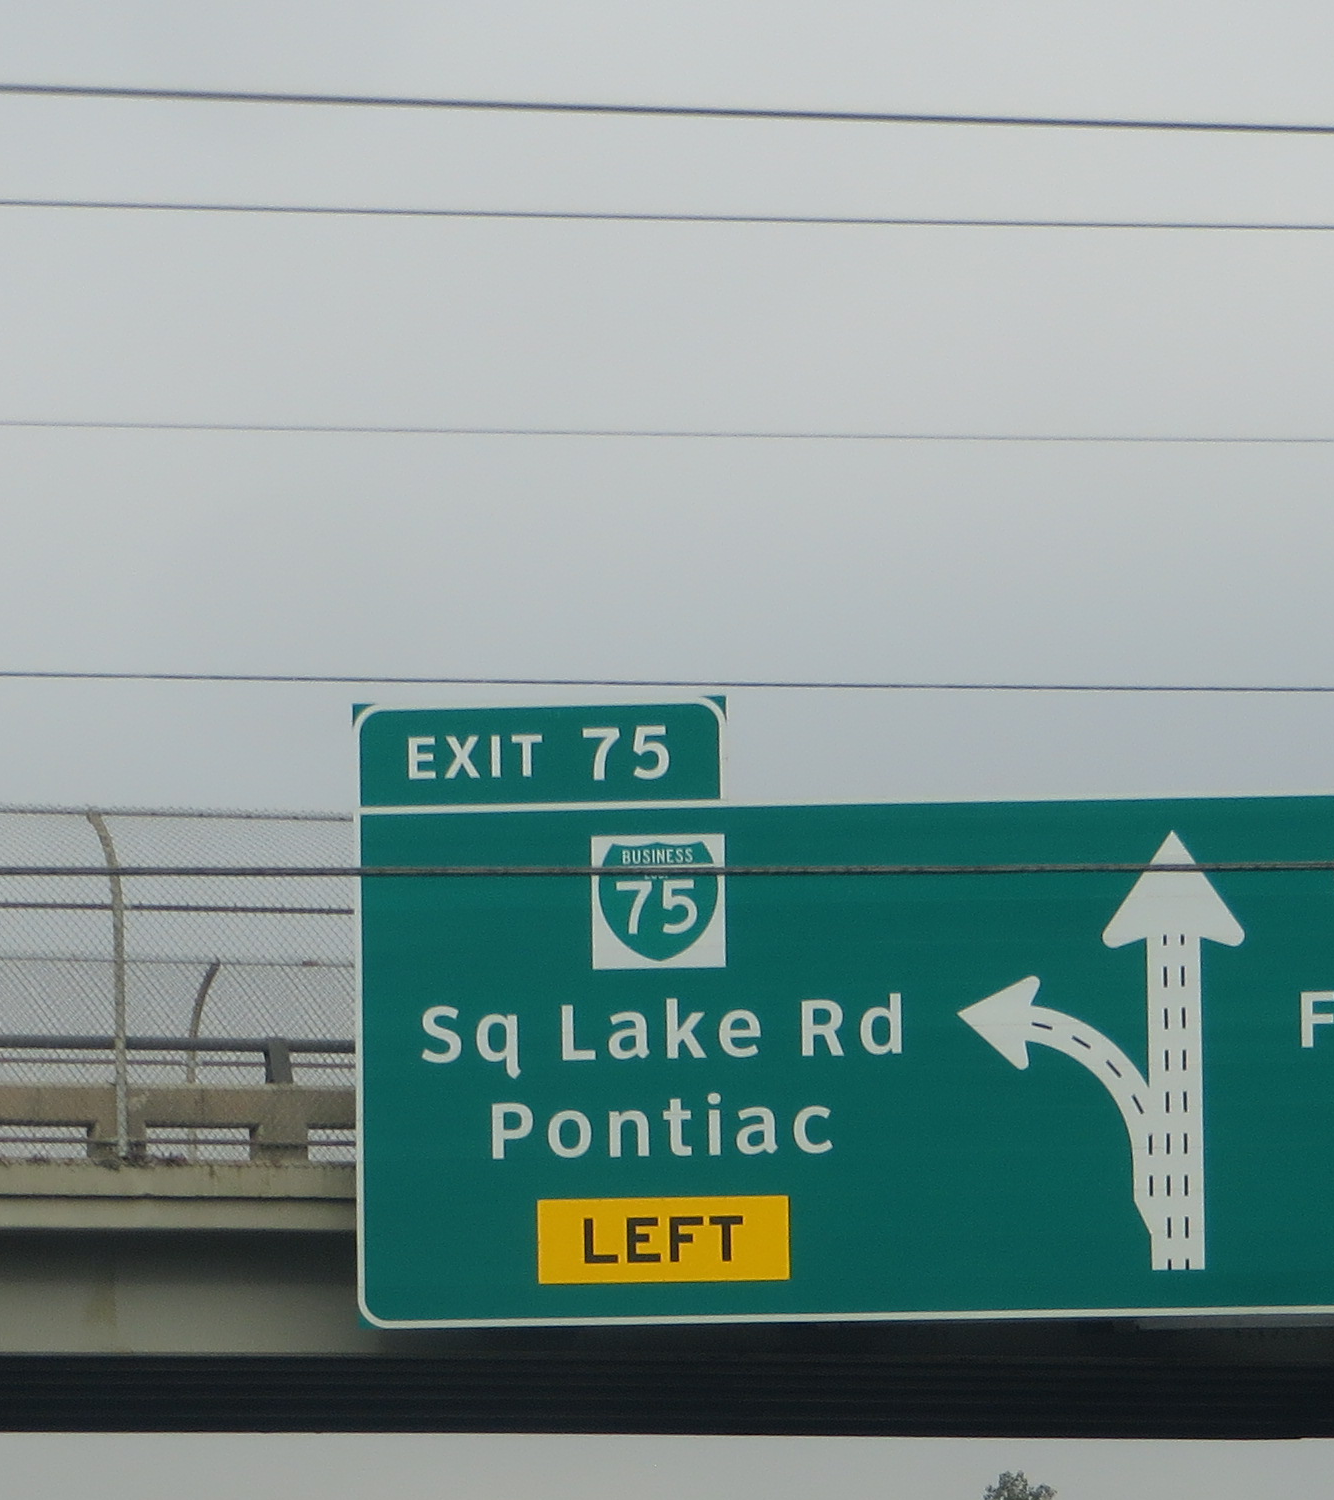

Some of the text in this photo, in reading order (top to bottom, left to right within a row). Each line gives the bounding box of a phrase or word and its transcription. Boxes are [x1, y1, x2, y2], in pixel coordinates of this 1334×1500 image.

[407, 725, 670, 781] EXIT 75
[622, 848, 694, 865] BUSINESS
[615, 879, 698, 935] 75
[421, 993, 903, 1079] Sq Lake Rd
[491, 1092, 834, 1160] Pontiac
[583, 1215, 744, 1264] LEFT
